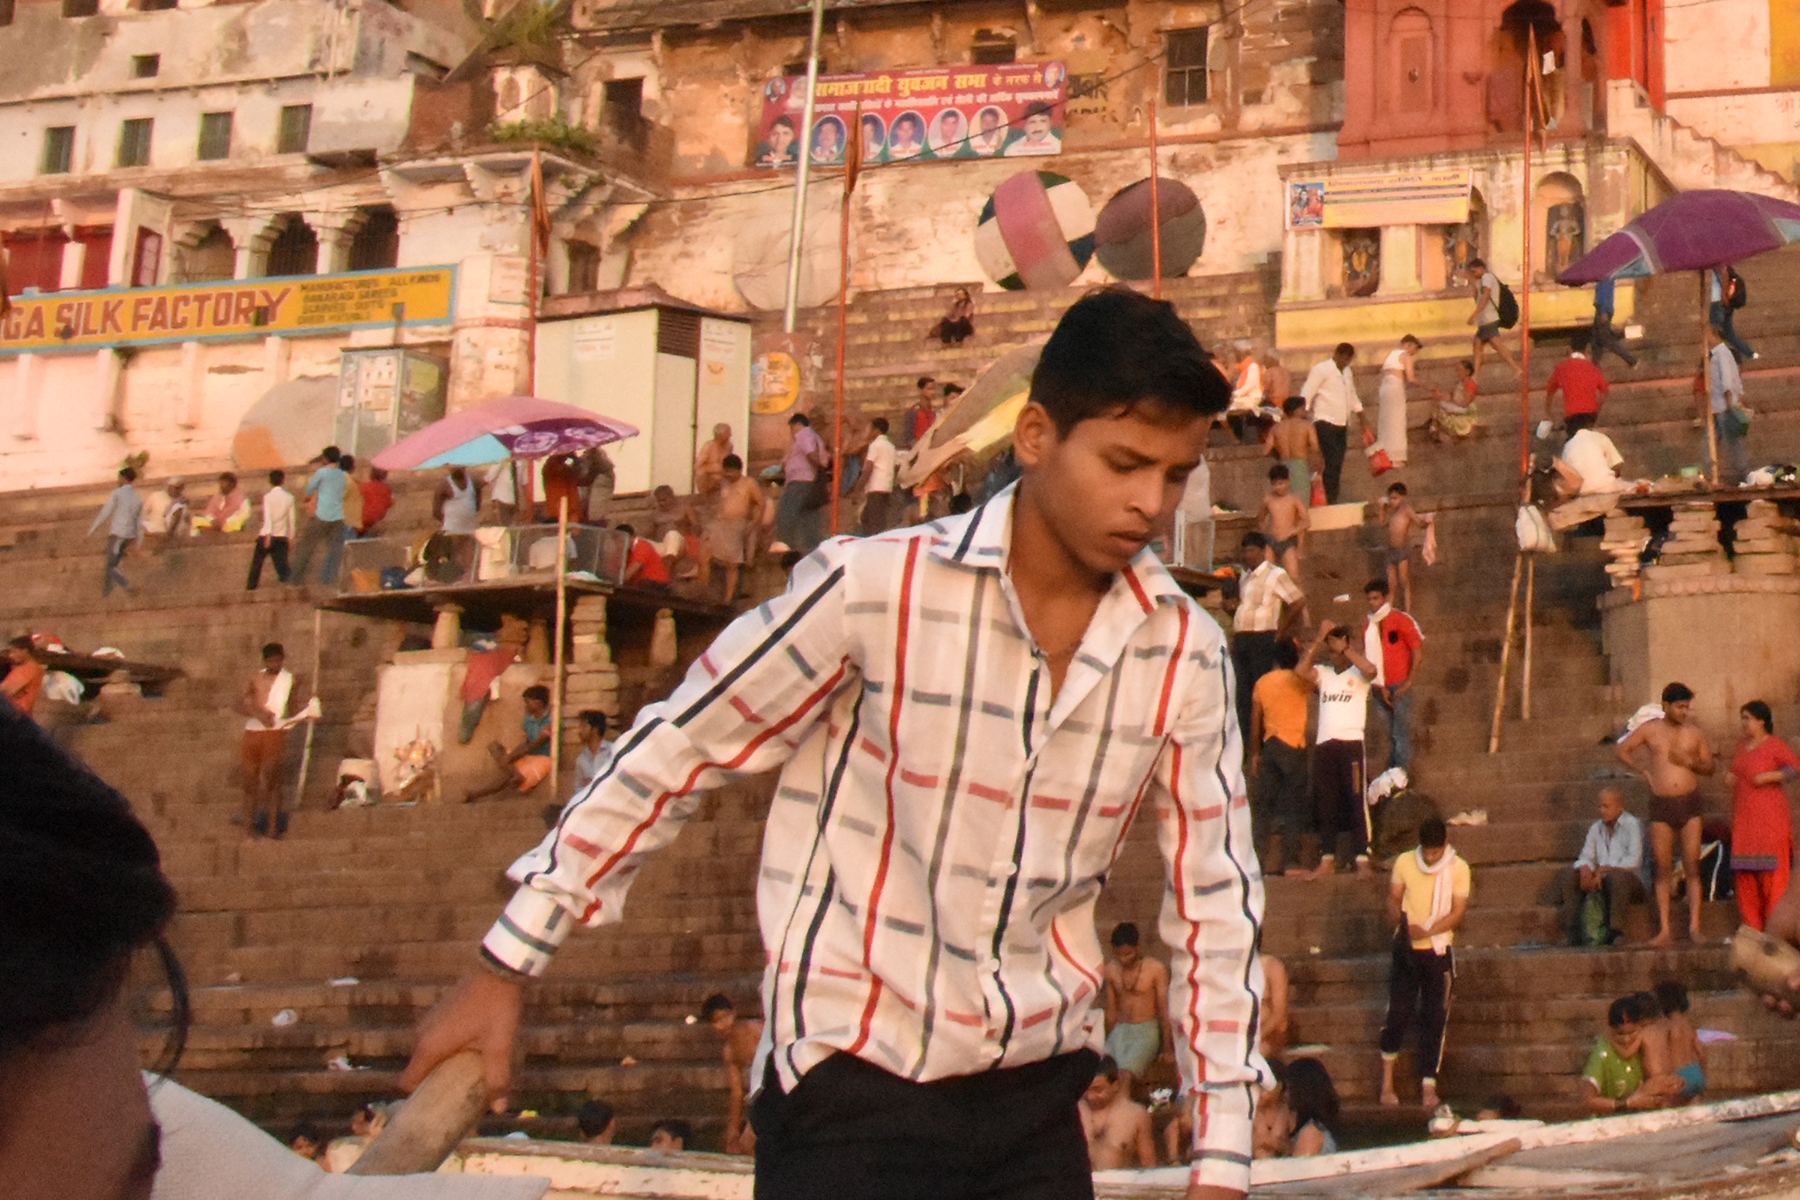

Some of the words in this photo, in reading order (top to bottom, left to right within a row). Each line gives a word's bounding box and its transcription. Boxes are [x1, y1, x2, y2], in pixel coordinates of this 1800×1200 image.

[54, 300, 124, 338] SILK
[131, 287, 293, 332] FACTORY
[1322, 690, 1352, 703] bwin
